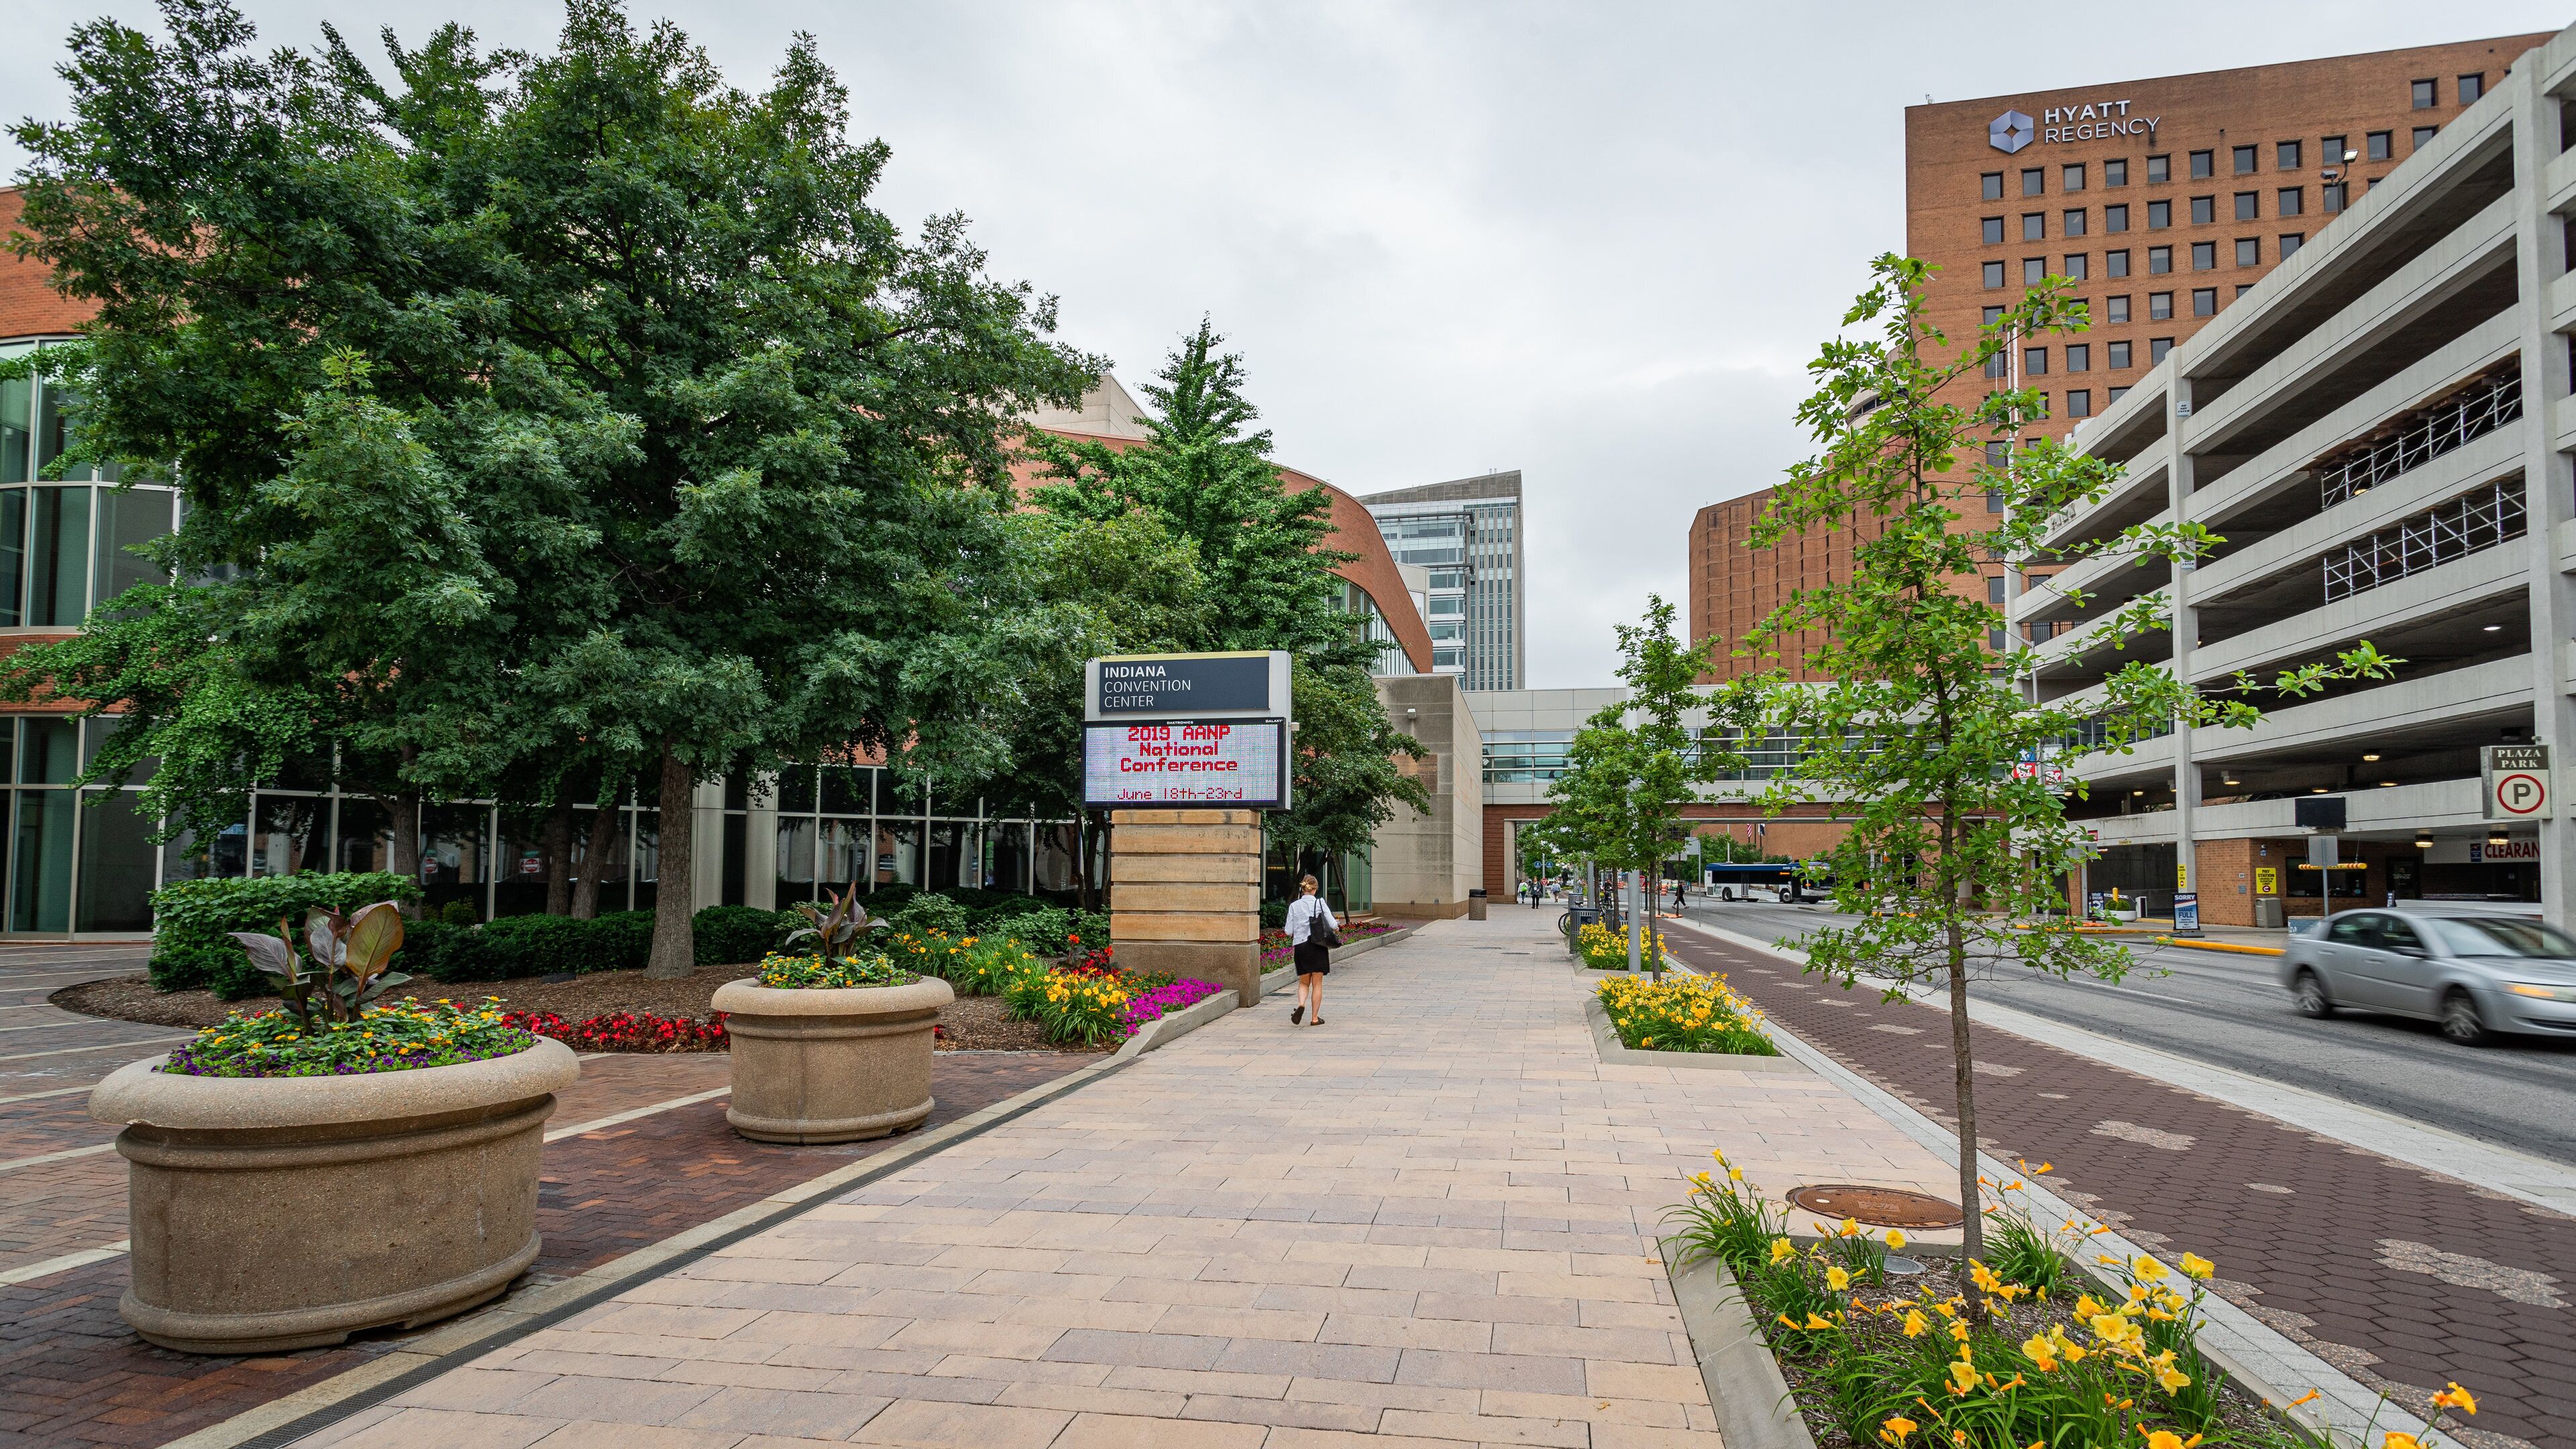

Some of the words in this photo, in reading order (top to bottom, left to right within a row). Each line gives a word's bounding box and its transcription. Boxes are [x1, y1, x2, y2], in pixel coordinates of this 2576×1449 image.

[2045, 100, 2131, 124] HYATT
[2045, 117, 2161, 144] REGENCY
[1105, 665, 1167, 678] INDIANA
[1104, 680, 1191, 693] CONVENTION
[1104, 695, 1154, 708] CENTER
[1128, 726, 1171, 742] 2019
[1183, 724, 1231, 741] AANP
[1140, 742, 1218, 756] National
[2498, 749, 2541, 757] PLAZA
[1120, 757, 1238, 772] Conference
[2501, 759, 2538, 768] PARK
[1117, 789, 1152, 800] June
[1164, 788, 1242, 800] 18th-23rd
[2513, 784, 2531, 804] P
